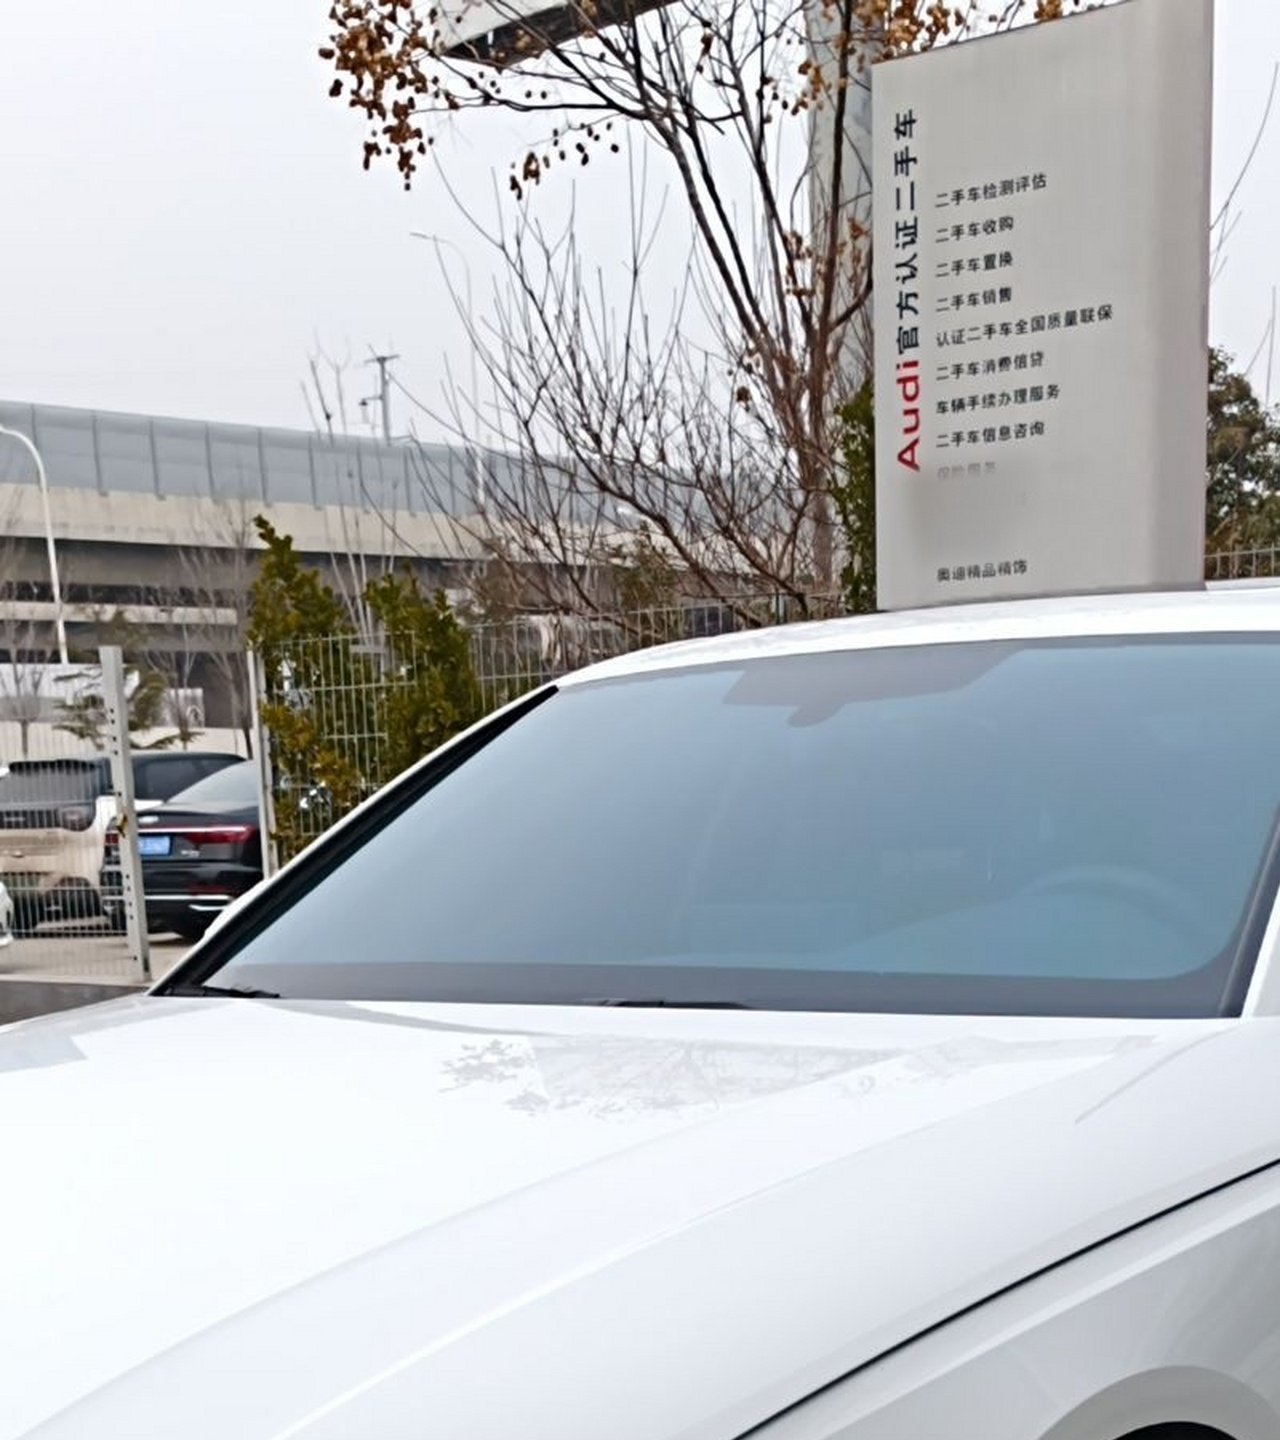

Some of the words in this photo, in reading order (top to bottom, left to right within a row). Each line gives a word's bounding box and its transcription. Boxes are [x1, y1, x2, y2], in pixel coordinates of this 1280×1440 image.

[935, 172, 1047, 207] 二手车检测评估
[935, 216, 1014, 243] 二手车收购
[935, 251, 1013, 277] 二手车置换
[935, 287, 1012, 312] 二手车销售
[936, 304, 1113, 347] 认证二手车全国质量联保
[936, 351, 1044, 381] 二手车消费信贷
[936, 384, 1060, 414] 车辆手续办理服务
[936, 421, 1045, 448] 二手车信息咨询
